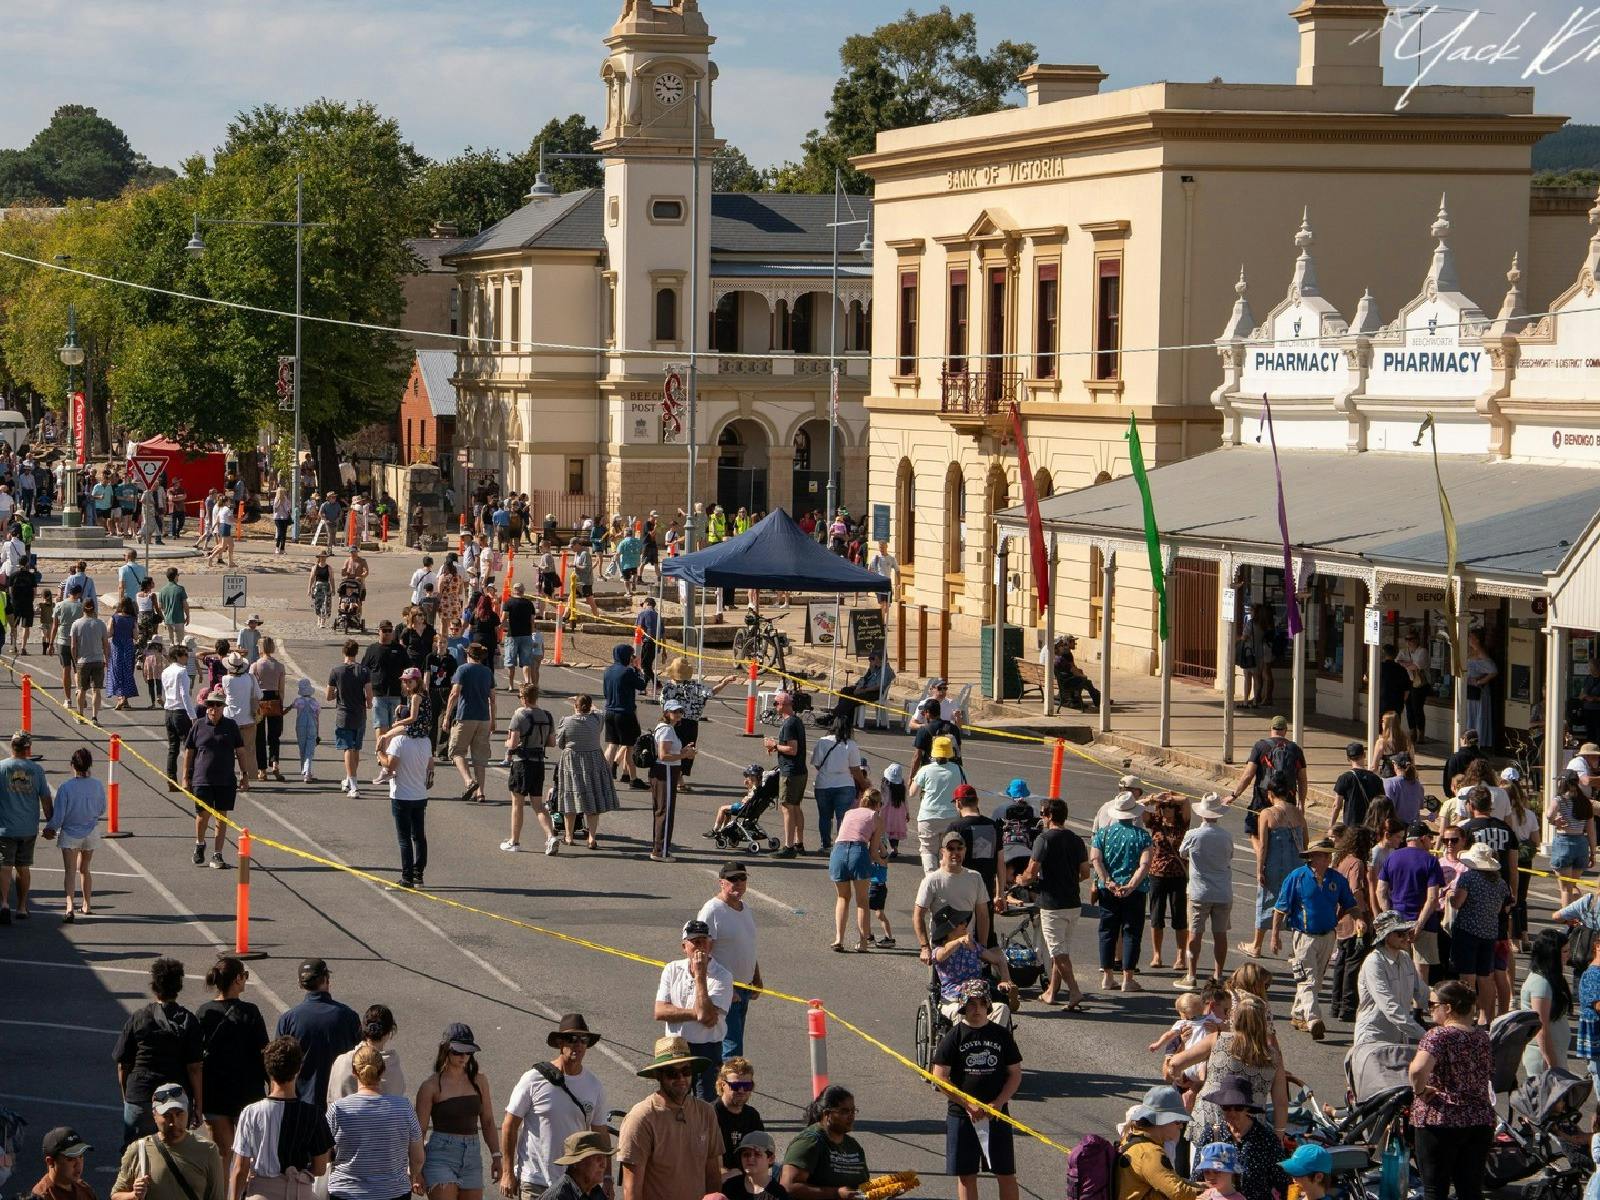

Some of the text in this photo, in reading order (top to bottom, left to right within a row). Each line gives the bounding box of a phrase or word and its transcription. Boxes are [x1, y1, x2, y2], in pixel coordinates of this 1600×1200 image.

[947, 157, 1065, 189] BANK OF VICTORIA
[1255, 352, 1339, 372] PHARMACY
[1384, 352, 1481, 373] PHARMACY
[630, 391, 702, 401] BEECHH
[631, 403, 656, 413] POST
[1565, 433, 1594, 447] BENDIGO
[1416, 592, 1447, 602] BENDI
